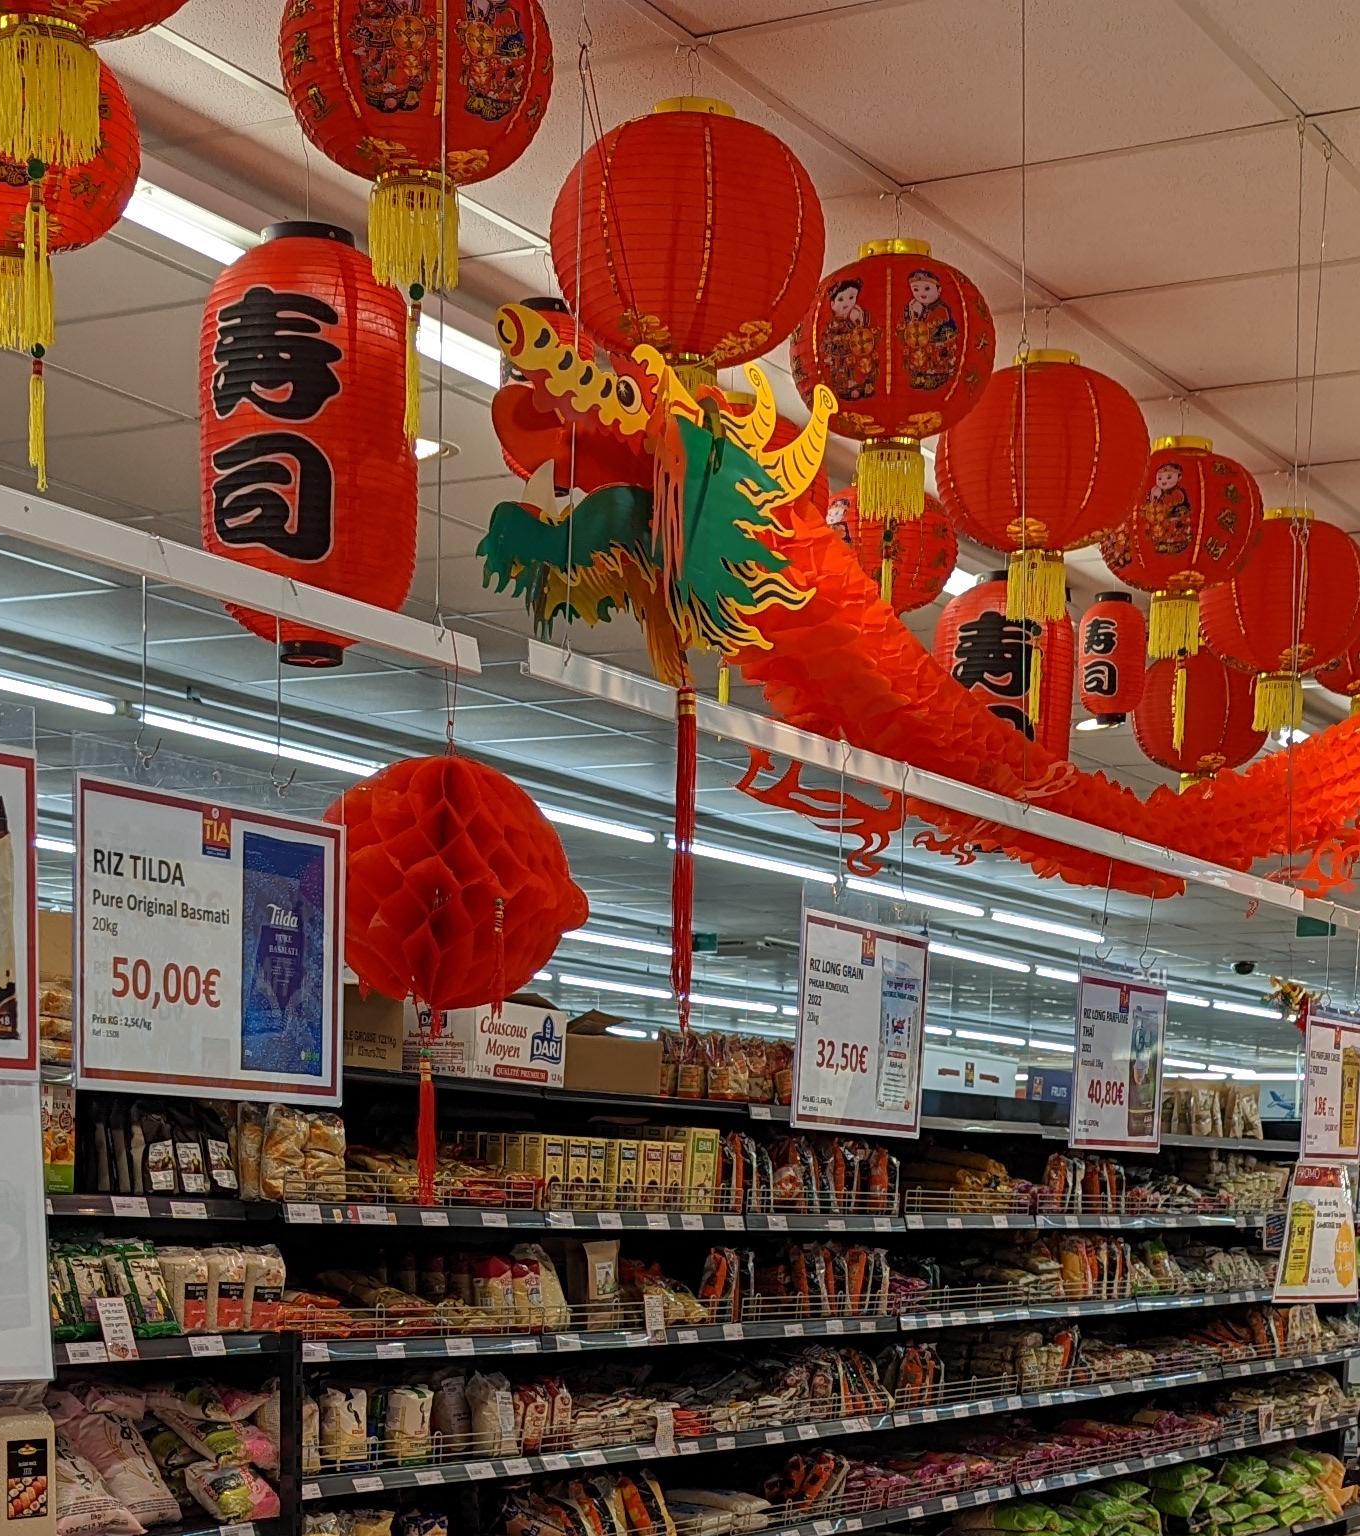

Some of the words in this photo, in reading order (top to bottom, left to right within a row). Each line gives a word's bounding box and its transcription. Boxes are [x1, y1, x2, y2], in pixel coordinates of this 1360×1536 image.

[204, 820, 230, 843] TIA
[93, 849, 123, 877] RIZ
[130, 855, 185, 886] TILDA
[92, 889, 123, 909] Pure
[127, 895, 178, 918] Original
[181, 902, 230, 924] Basmati
[267, 904, 298, 928] Tilda
[92, 917, 118, 936] 20kg
[862, 939, 875, 956] TIA
[810, 958, 820, 972] RIZ
[823, 961, 841, 975] LONG
[843, 964, 864, 980] GRAIN
[111, 957, 221, 1009] 50,00€
[92, 1014, 106, 1024] Prix
[108, 1016, 118, 1026] KG
[480, 1016, 528, 1039] Couscous
[486, 1038, 521, 1061] Moyen
[533, 1040, 561, 1058] DARI
[816, 1039, 868, 1075] 32,50€
[1051, 1086, 1067, 1097] FRUITS
[1088, 1079, 1124, 1109] 40,80€
